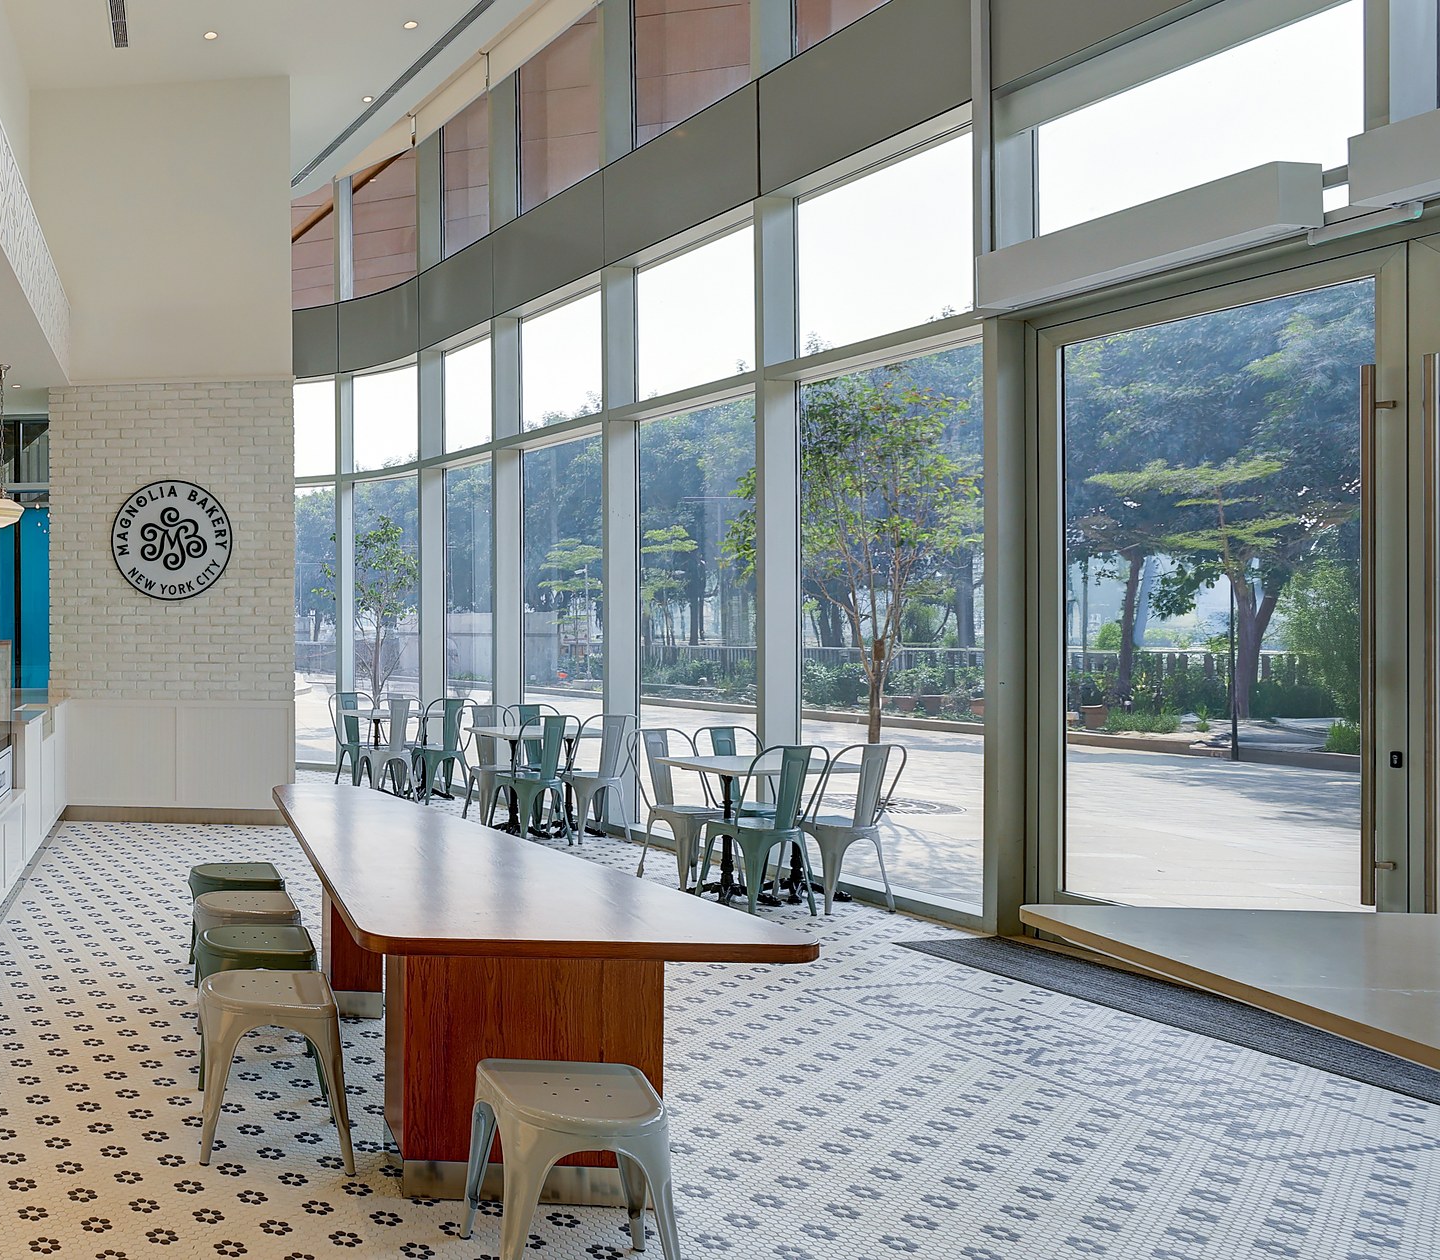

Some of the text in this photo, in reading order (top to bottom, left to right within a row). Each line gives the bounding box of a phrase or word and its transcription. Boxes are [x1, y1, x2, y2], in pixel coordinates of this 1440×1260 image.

[116, 485, 227, 557] MAGNOLIA BAKERY
[127, 558, 221, 595] NEW YORK CITY
